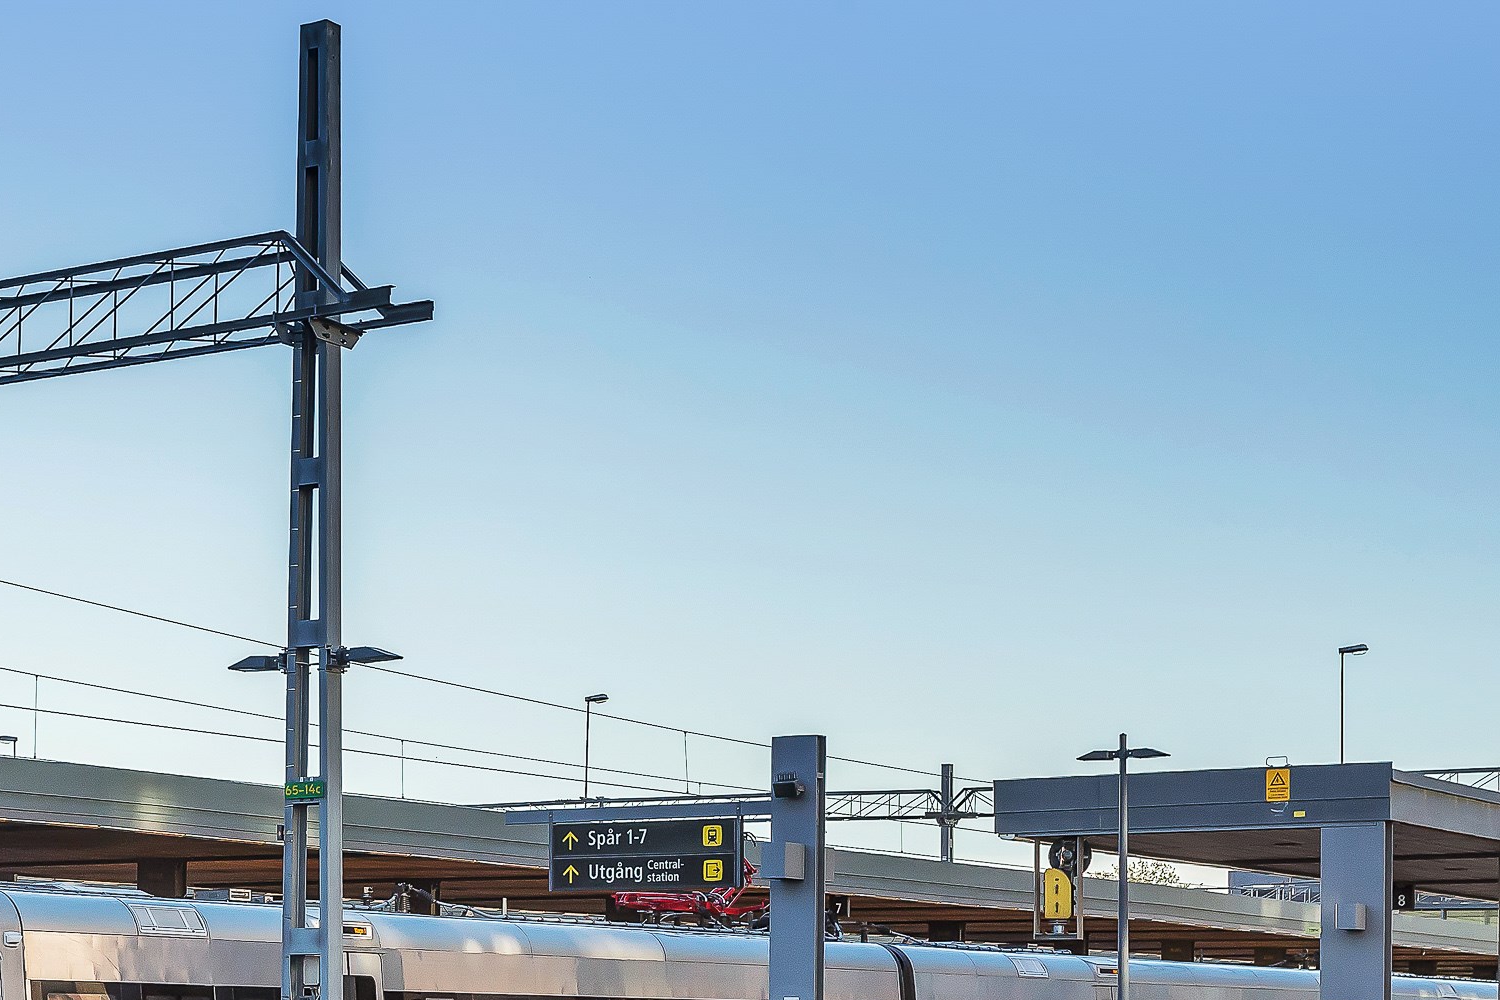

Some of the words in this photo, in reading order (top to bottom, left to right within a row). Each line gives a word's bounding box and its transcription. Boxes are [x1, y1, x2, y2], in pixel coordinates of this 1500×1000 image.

[285, 783, 321, 796] 65-14c
[588, 827, 622, 850] Spår
[626, 828, 648, 845] 1-7
[647, 858, 685, 871] Central-
[588, 862, 643, 883] Utgång
[647, 872, 680, 883] station
[1397, 894, 1406, 907] 8
[835, 902, 842, 914] 7
